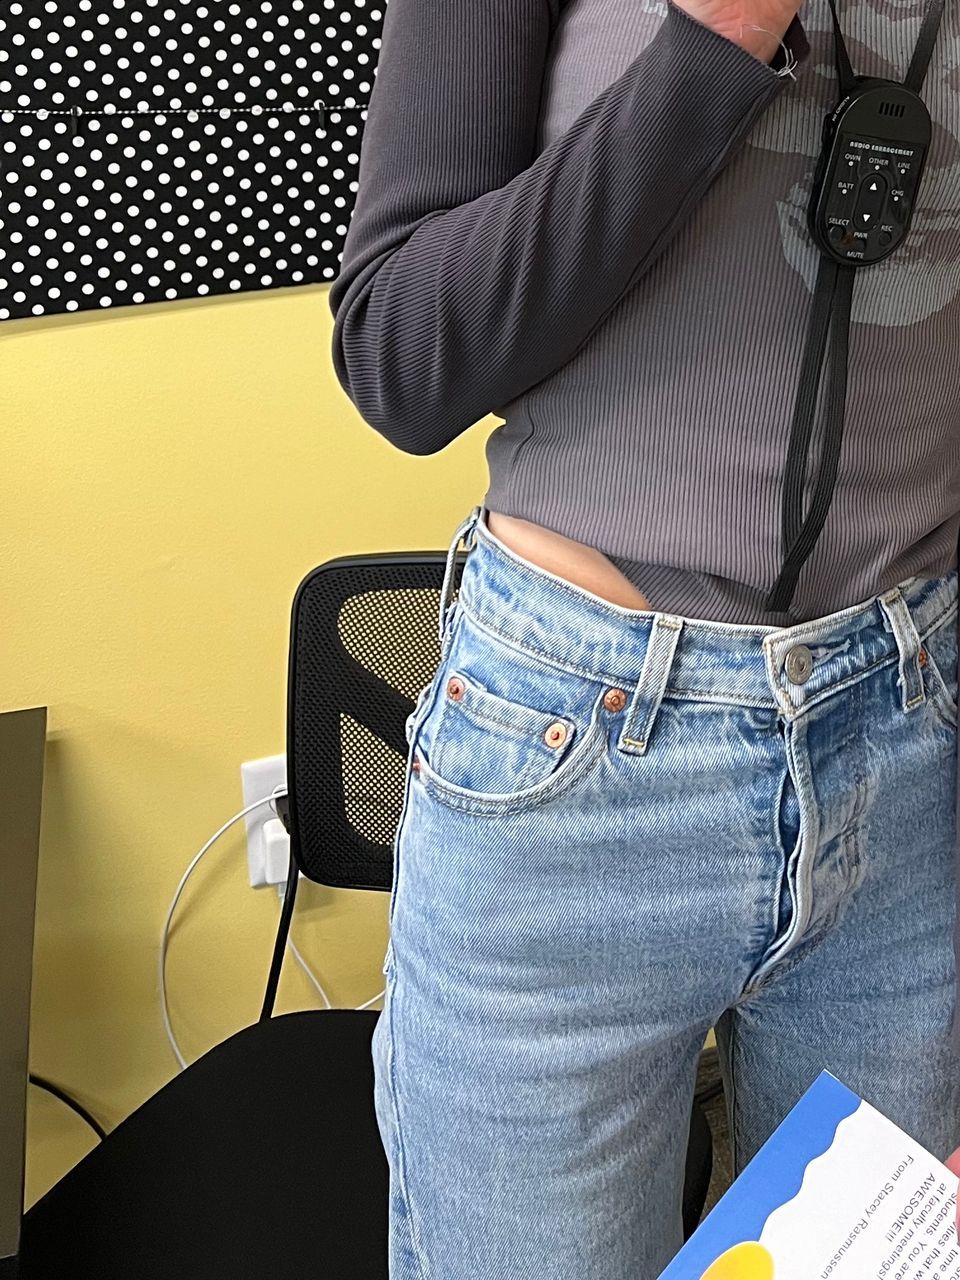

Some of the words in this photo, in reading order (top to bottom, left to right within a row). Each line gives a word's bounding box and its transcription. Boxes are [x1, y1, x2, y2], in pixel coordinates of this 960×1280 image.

[844, 153, 861, 161] OWN
[868, 157, 889, 166] OTHER
[838, 182, 855, 190] BATT
[828, 217, 850, 226] SELECT
[846, 251, 864, 259] MUTE
[891, 1154, 915, 1181] From
[865, 1182, 894, 1218] Stacey
[936, 1183, 947, 1196] at
[885, 1172, 937, 1243] AWESOME!!!
[911, 1195, 941, 1229] faculty
[820, 1218, 869, 1280] Rasmussen
[908, 1241, 928, 1262] You
[922, 1248, 941, 1270] that
